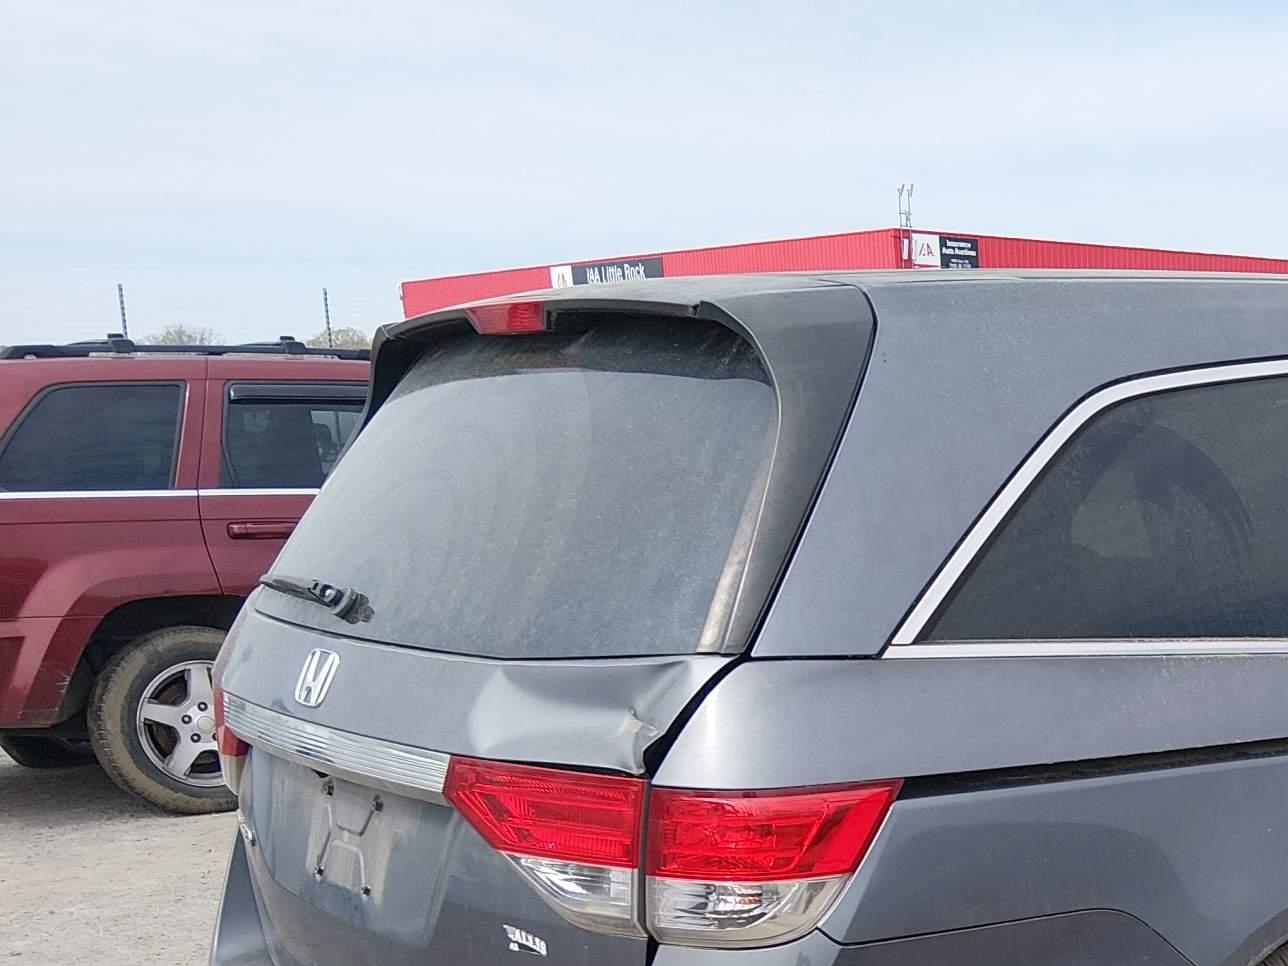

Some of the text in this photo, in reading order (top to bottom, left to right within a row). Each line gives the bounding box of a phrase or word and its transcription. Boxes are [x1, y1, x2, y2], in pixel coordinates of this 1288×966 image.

[585, 266, 601, 284] IAA
[601, 264, 623, 283] Little
[623, 262, 647, 281] Rock
